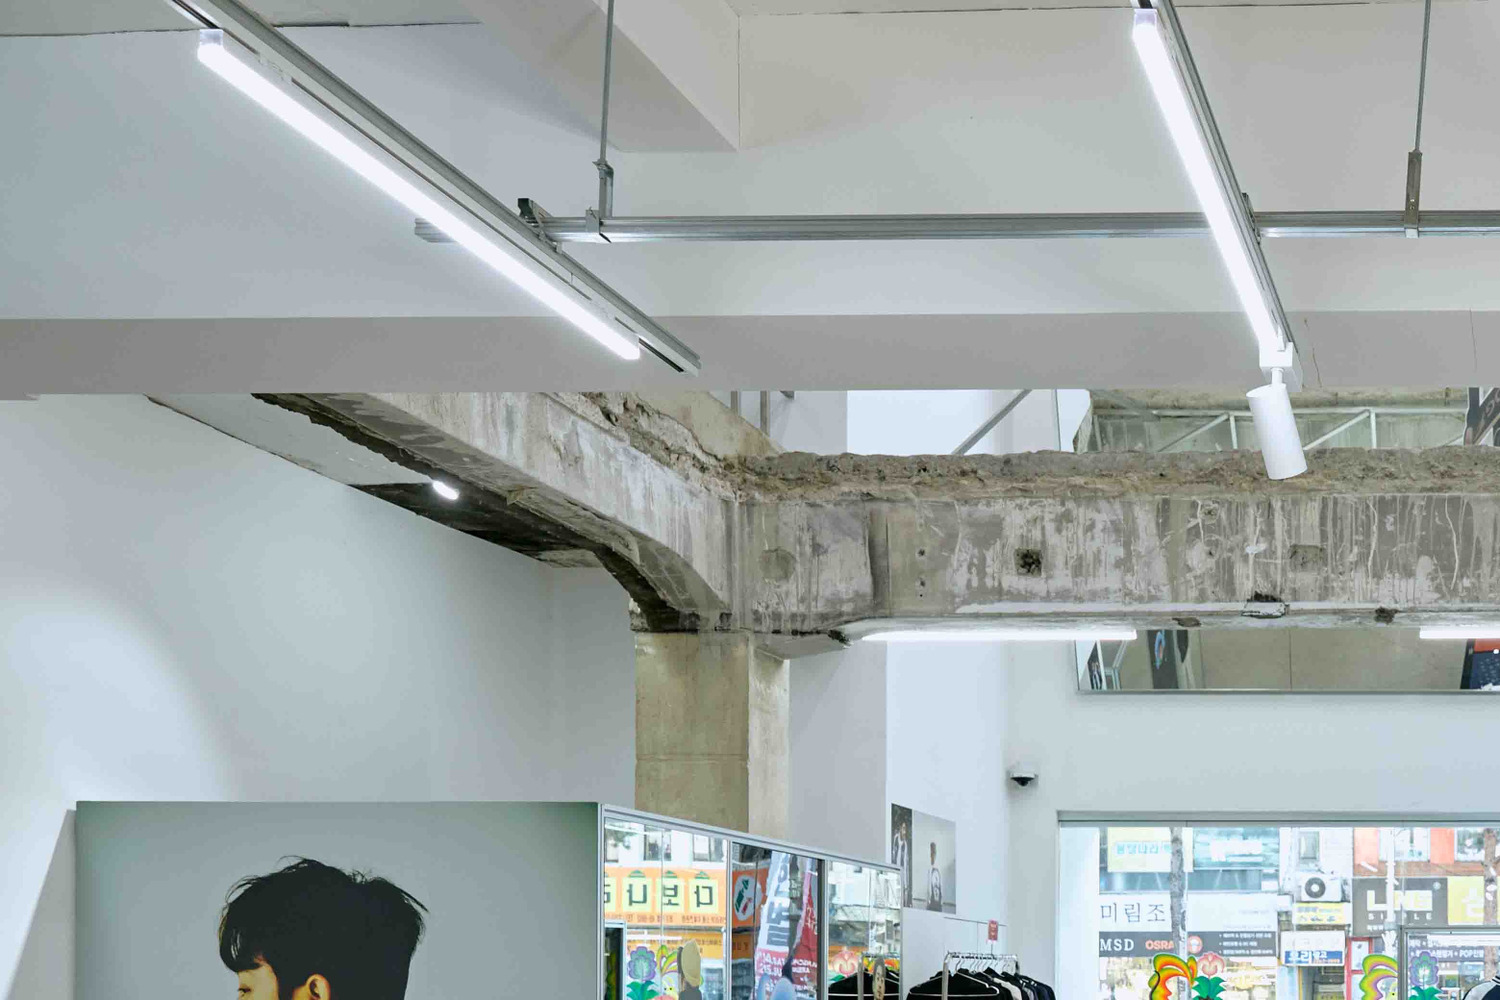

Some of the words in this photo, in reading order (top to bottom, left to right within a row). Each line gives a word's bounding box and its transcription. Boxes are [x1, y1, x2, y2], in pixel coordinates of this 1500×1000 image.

[1100, 902, 1166, 923] 미림조
[1100, 938, 1135, 951] MSD
[1145, 940, 1175, 951] OSRA
